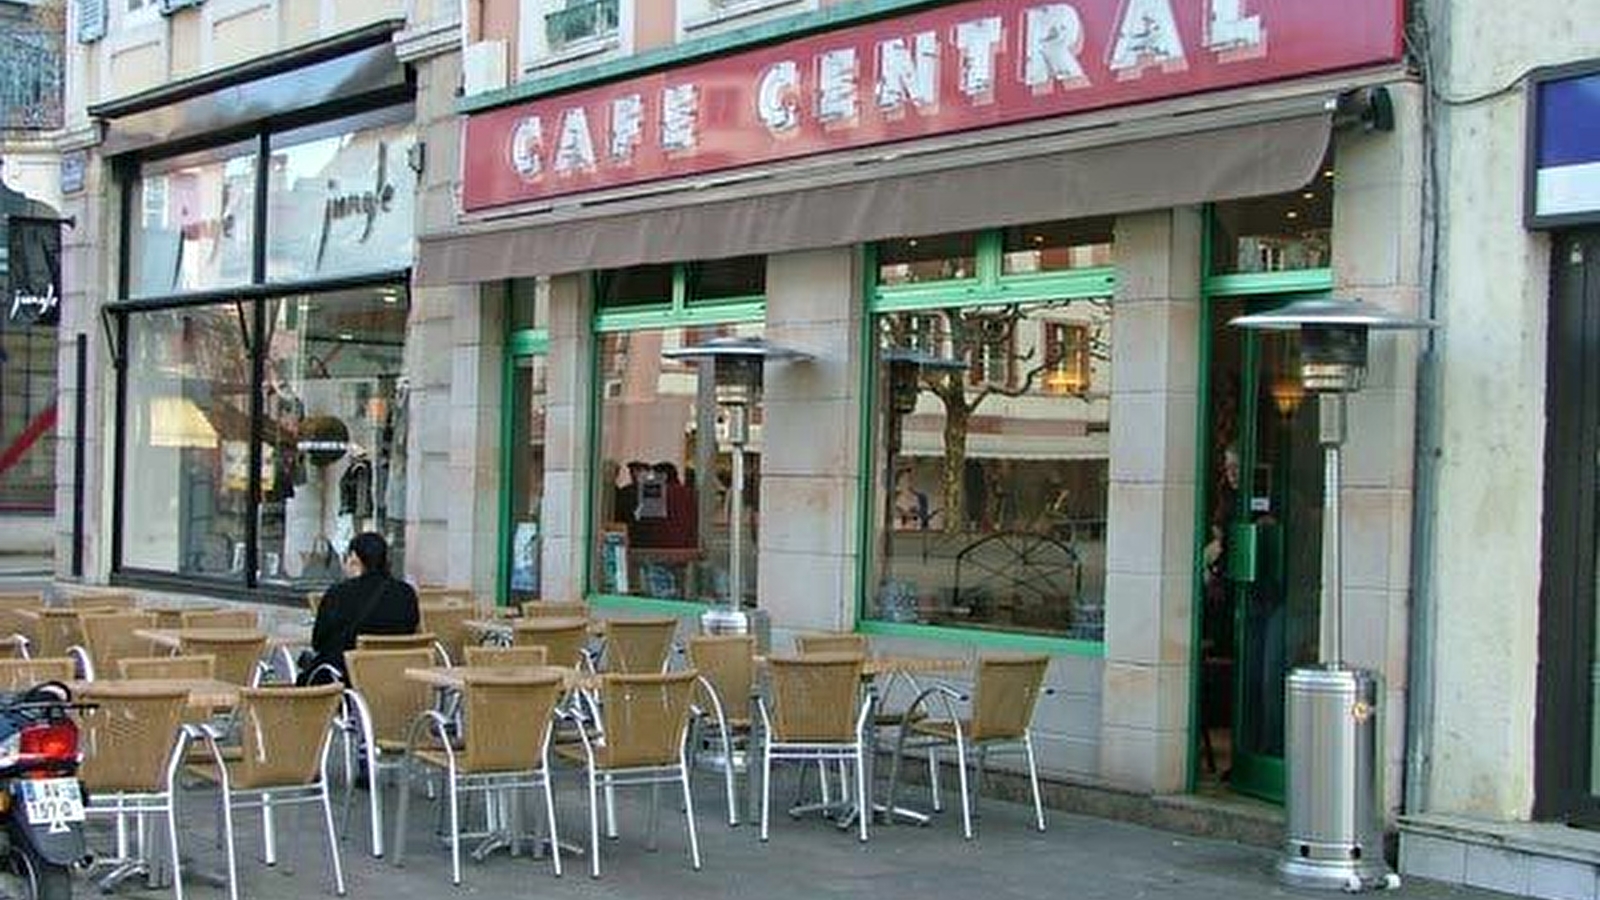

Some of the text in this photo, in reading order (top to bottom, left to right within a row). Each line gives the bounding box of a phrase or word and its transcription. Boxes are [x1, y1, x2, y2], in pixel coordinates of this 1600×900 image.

[511, 0, 1267, 180] CAFE CENTRAL
[316, 141, 395, 272] jungle
[9, 283, 58, 320] jungle
